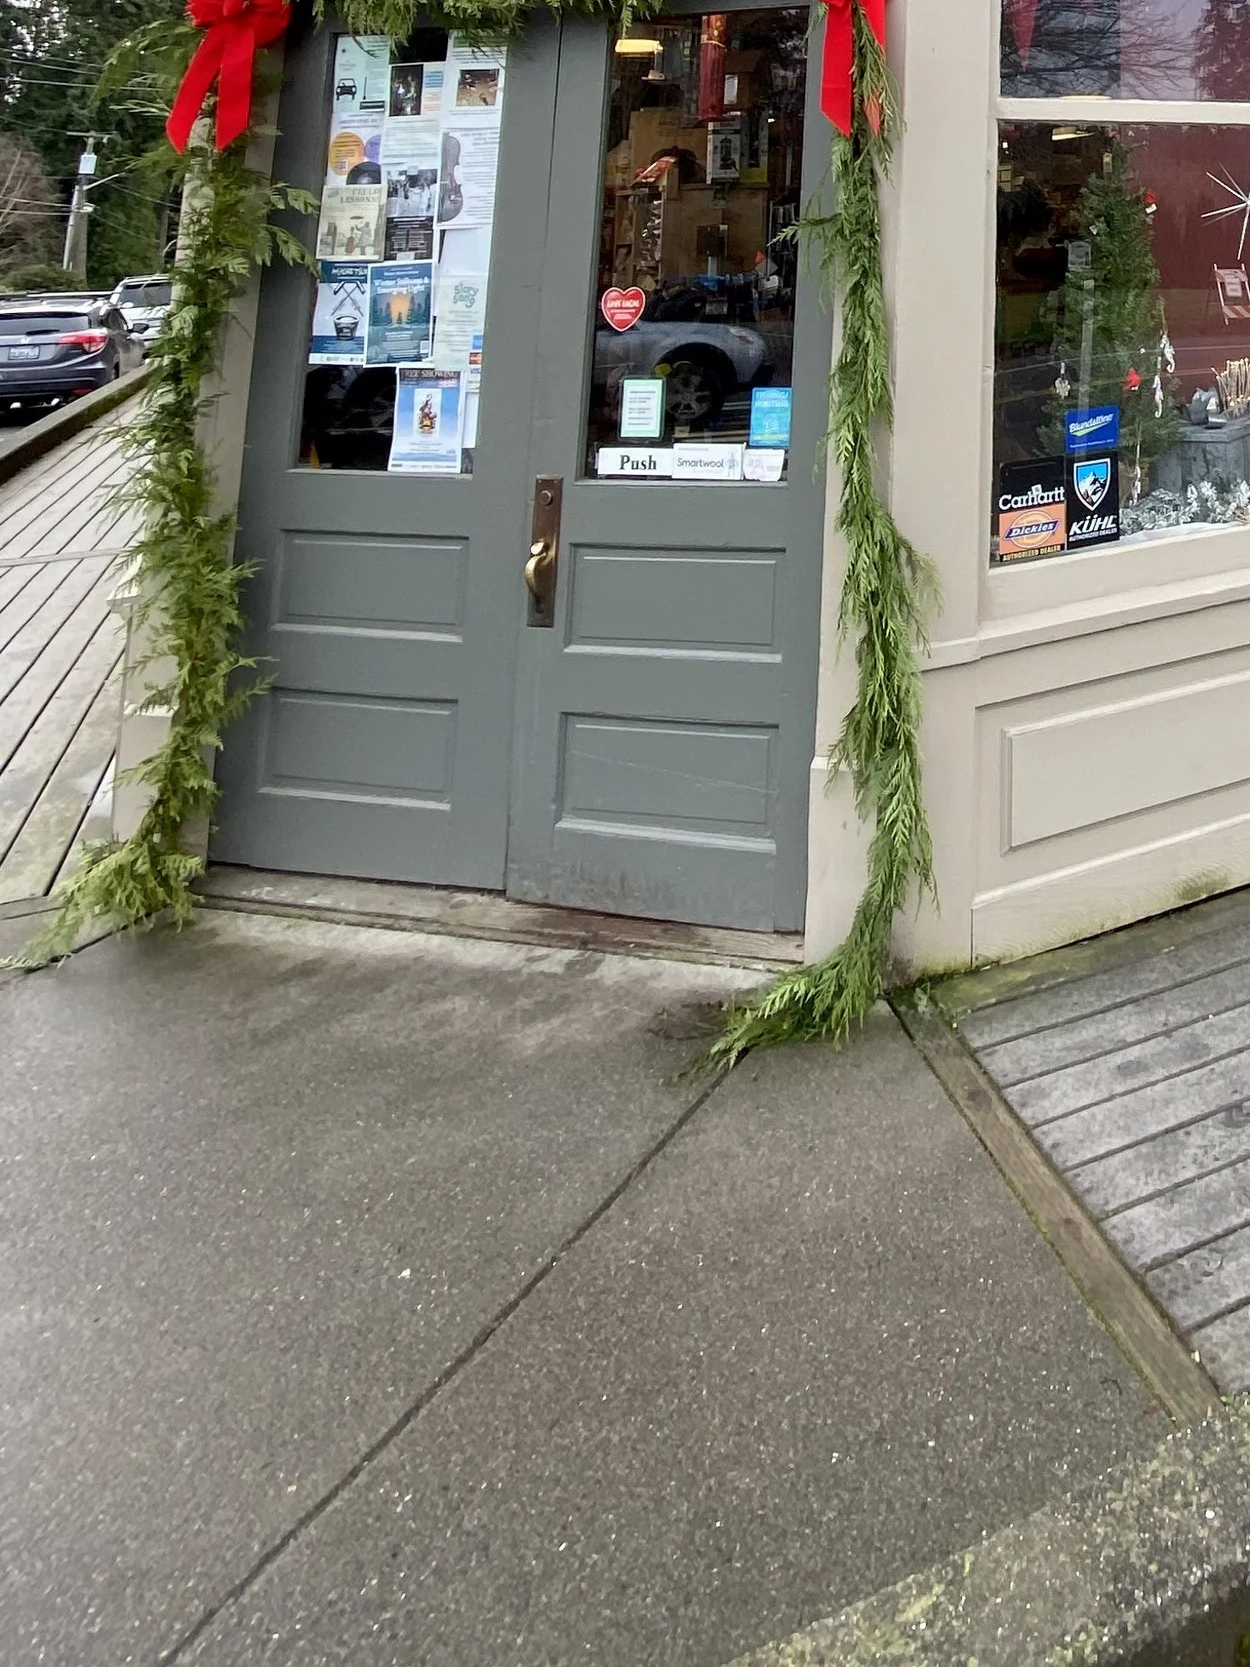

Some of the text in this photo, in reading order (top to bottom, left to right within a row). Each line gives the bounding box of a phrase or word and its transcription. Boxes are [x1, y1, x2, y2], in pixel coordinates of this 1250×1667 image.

[619, 454, 657, 471] Push
[676, 456, 725, 469] Smartwool
[998, 485, 1066, 511] Carhartt
[1008, 522, 1056, 538] Dickies
[1068, 514, 1118, 536] KÜHL
[1069, 527, 1118, 542] AUTHORIZED DEALER
[1002, 544, 1061, 562] AUTHORIZED DEALER
